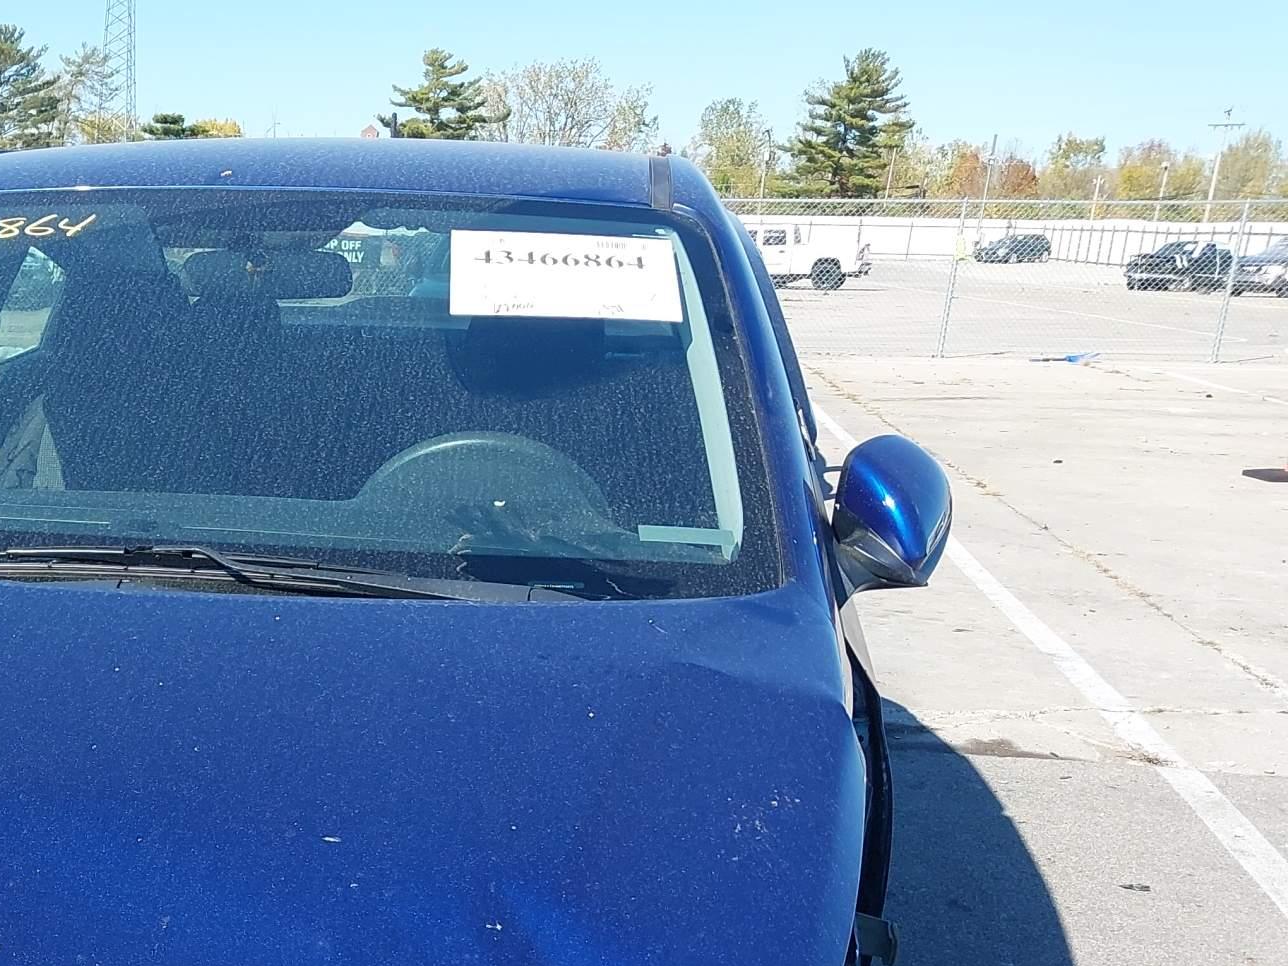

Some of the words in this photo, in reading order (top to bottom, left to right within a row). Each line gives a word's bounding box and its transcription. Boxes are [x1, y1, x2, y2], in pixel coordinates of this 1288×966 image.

[341, 240, 362, 250] OFF
[337, 250, 365, 263] NLY
[474, 248, 647, 270] 43466864
